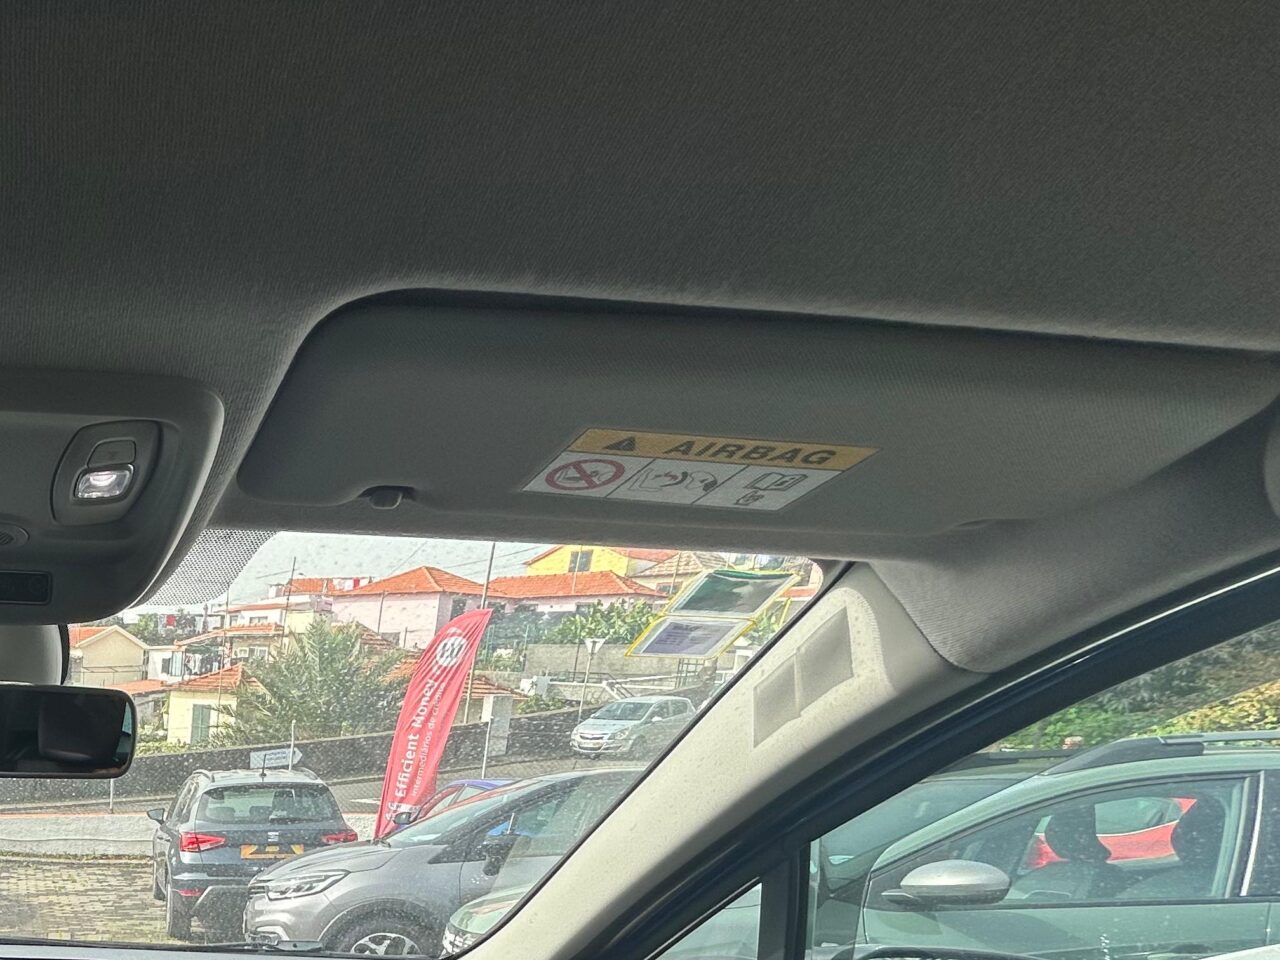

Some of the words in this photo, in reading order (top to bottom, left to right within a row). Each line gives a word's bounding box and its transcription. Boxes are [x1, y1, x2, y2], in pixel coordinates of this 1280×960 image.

[663, 439, 839, 466] AIRBAG
[394, 732, 420, 798] Efficient
[411, 679, 438, 728] Money
